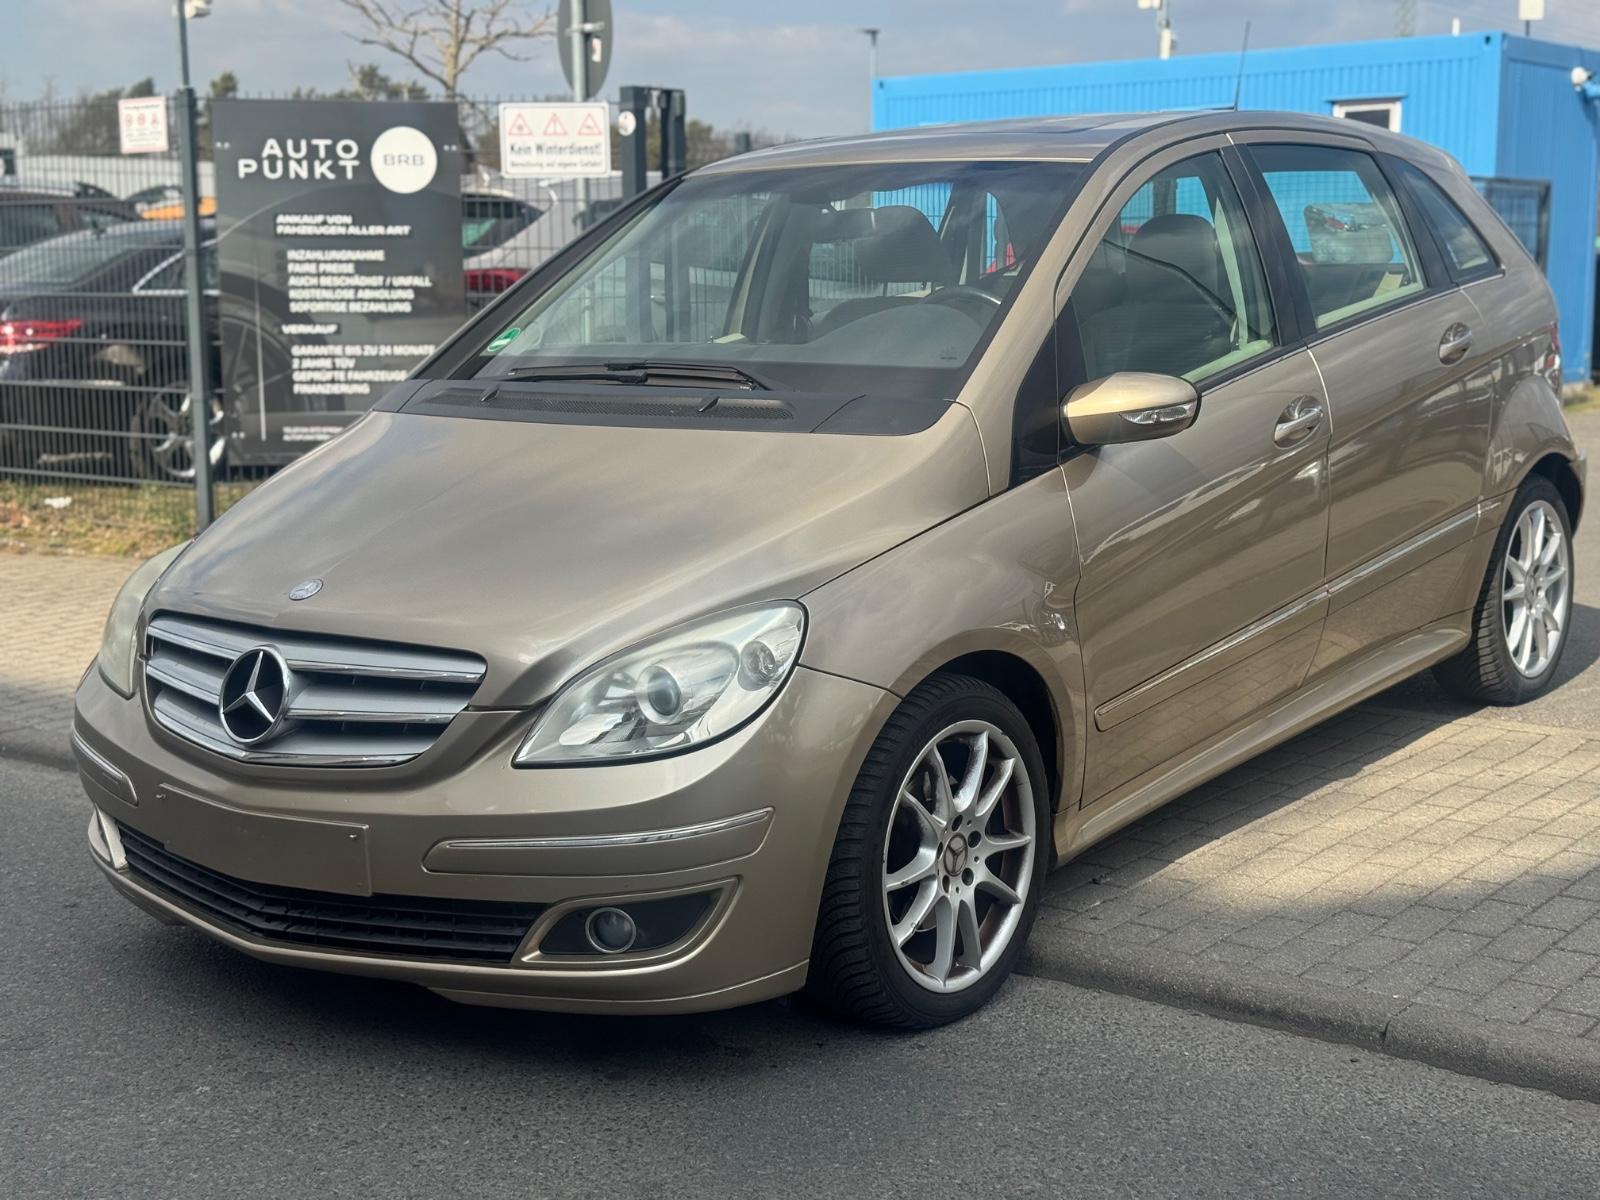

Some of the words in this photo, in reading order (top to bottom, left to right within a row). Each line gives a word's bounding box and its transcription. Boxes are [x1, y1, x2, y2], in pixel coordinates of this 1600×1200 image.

[261, 137, 359, 159] AUTO
[510, 143, 532, 155] Kein
[383, 153, 425, 166] BRB
[238, 158, 360, 180] PUNKT
[276, 214, 325, 224] ANKAUF
[326, 214, 353, 224] VON
[347, 225, 385, 235] ALLER
[386, 225, 411, 235] ART
[287, 262, 318, 274] FAIRE
[319, 262, 355, 274] PREISE
[288, 275, 318, 287] AUCH
[392, 275, 432, 287] UNFALL
[289, 288, 356, 300] KOSTENLOSE
[356, 288, 415, 300] ABHOLUNG
[289, 301, 347, 313] SOFORTIGE
[349, 301, 412, 313] BEZAHLUNG
[281, 324, 338, 335] VERKAUF
[291, 345, 344, 356] GARANTIE
[344, 345, 362, 356] BIS
[363, 345, 378, 356] ZU
[379, 345, 392, 356] 24
[301, 358, 333, 369] JAHRE
[292, 369, 346, 381] GEPRÜFTE
[293, 383, 371, 395] FINANZIERUNG
